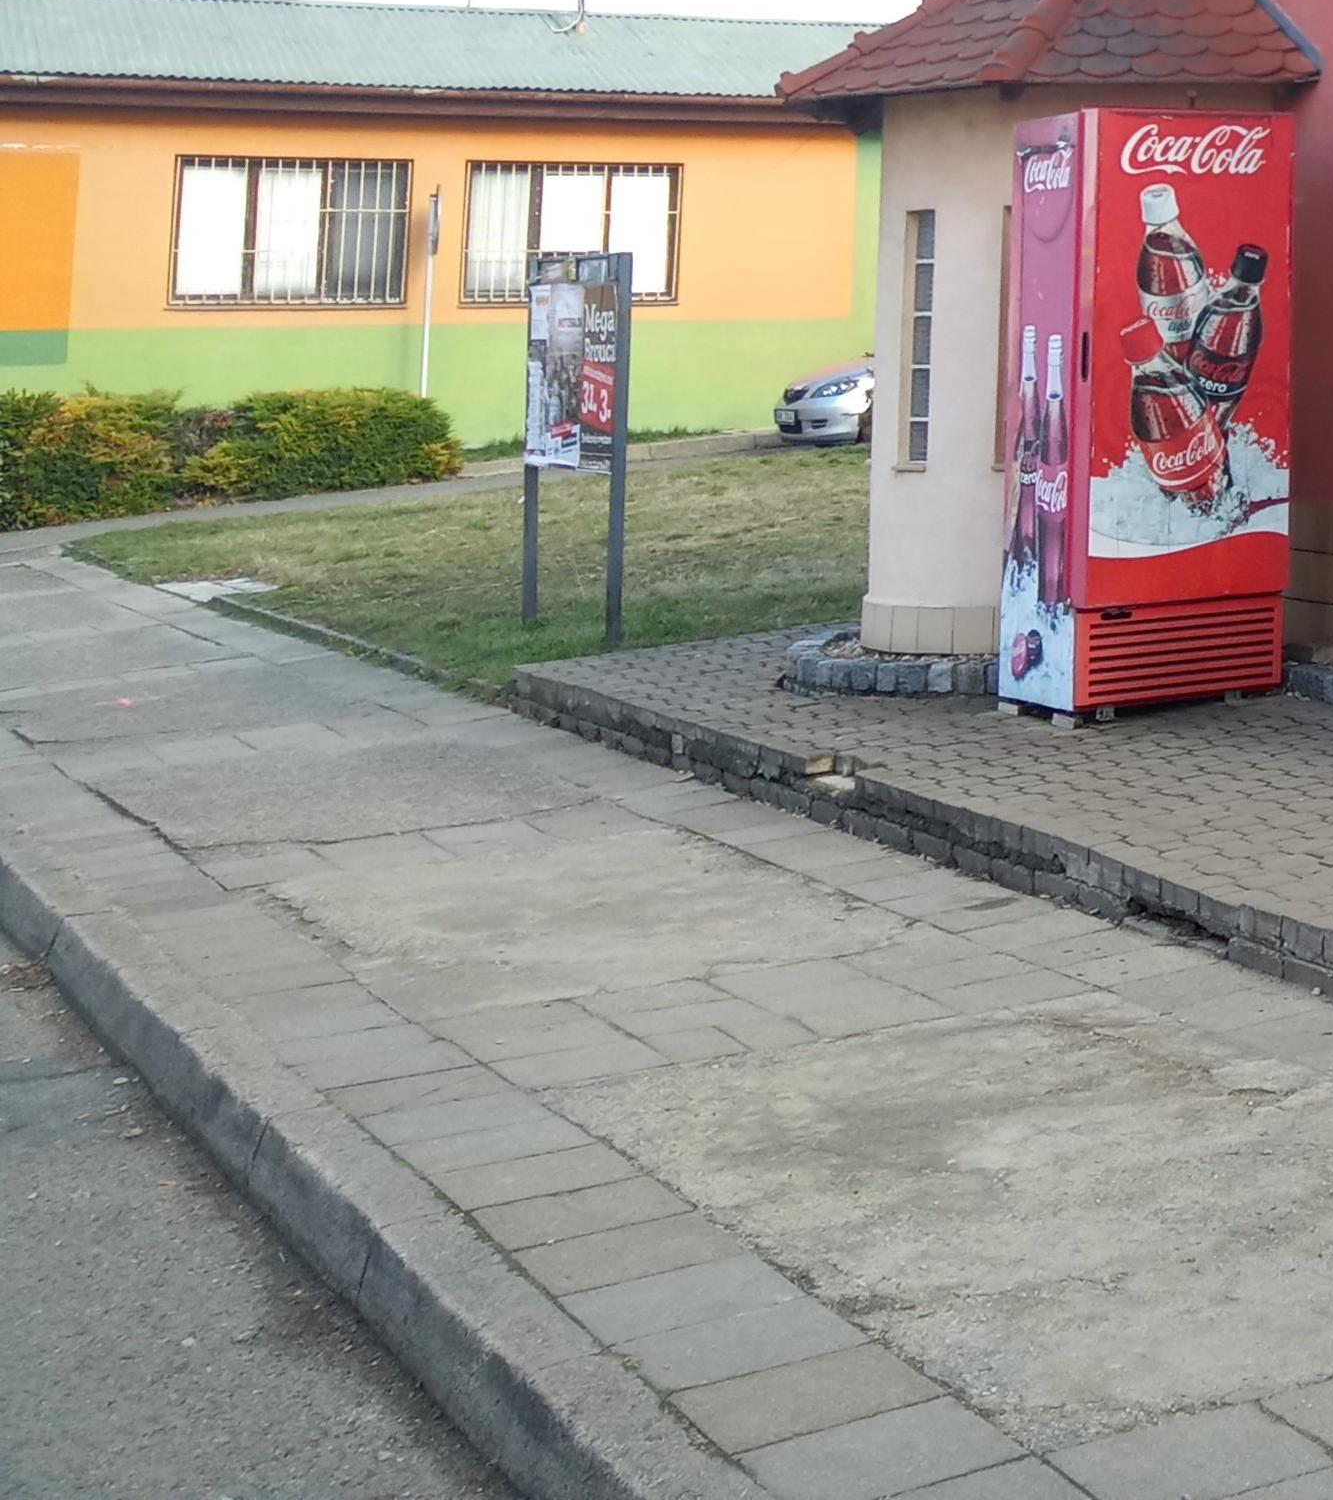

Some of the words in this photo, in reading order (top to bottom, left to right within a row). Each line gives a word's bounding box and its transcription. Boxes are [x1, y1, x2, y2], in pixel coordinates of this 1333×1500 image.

[1121, 124, 1271, 175] Coca-Cola
[584, 303, 614, 341] Mega
[1199, 376, 1228, 394] zero
[1152, 430, 1215, 475] Coca-Cola
